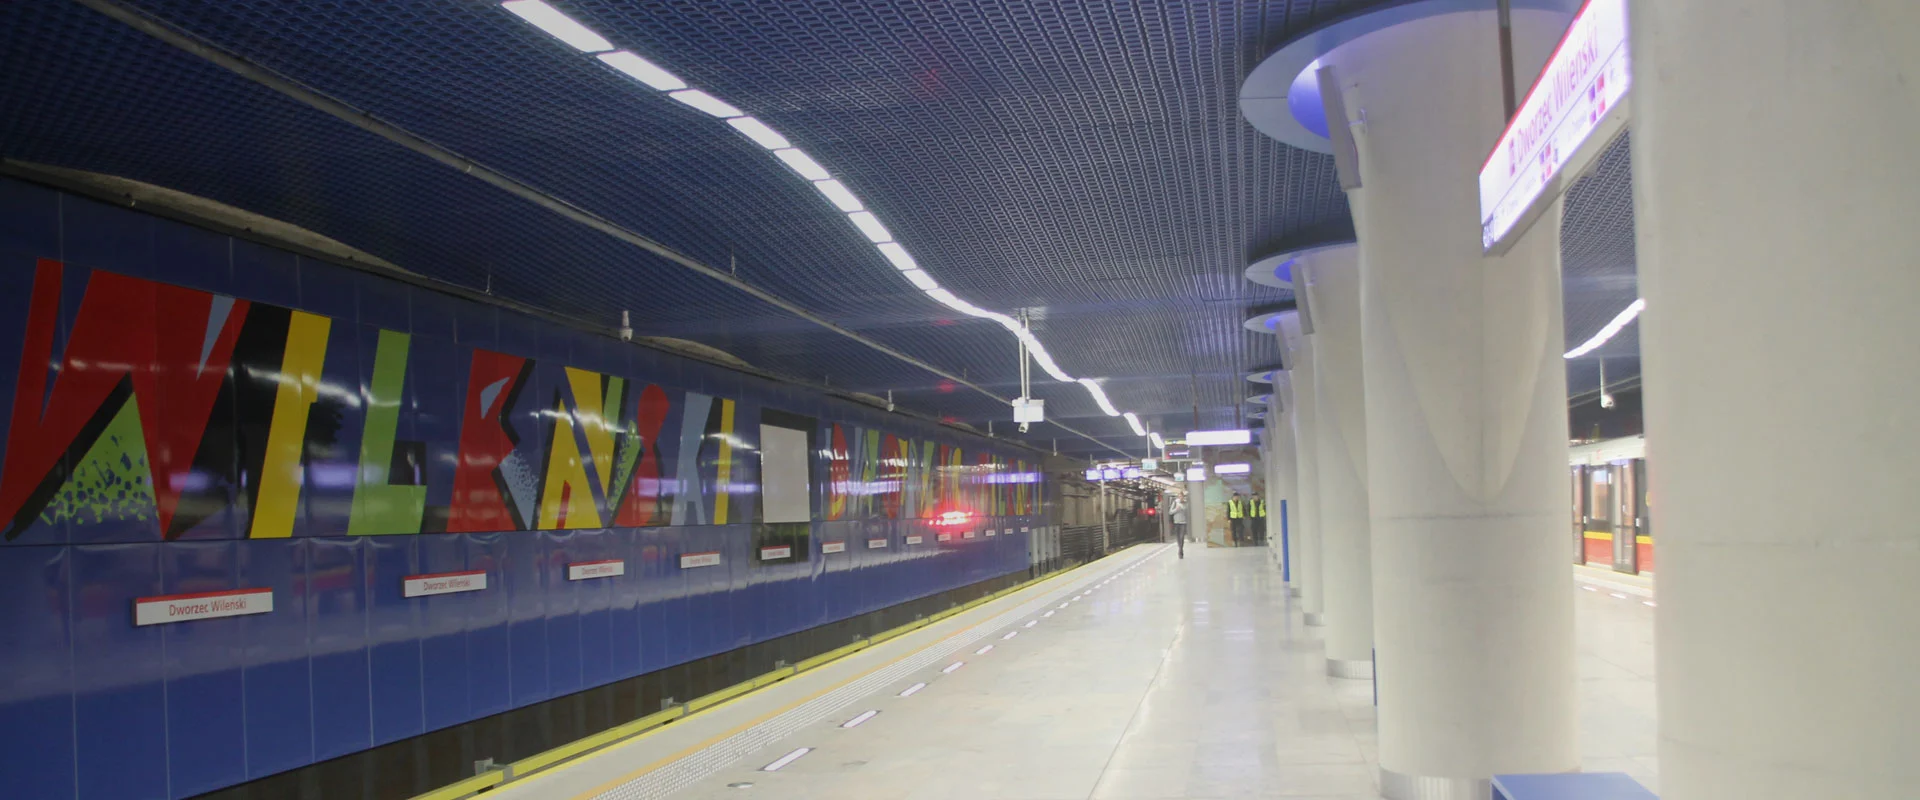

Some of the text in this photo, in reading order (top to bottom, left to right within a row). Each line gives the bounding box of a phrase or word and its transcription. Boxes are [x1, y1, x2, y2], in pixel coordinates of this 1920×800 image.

[1517, 91, 1553, 164] Dworzec
[169, 598, 247, 616] Dworzec Wileński
